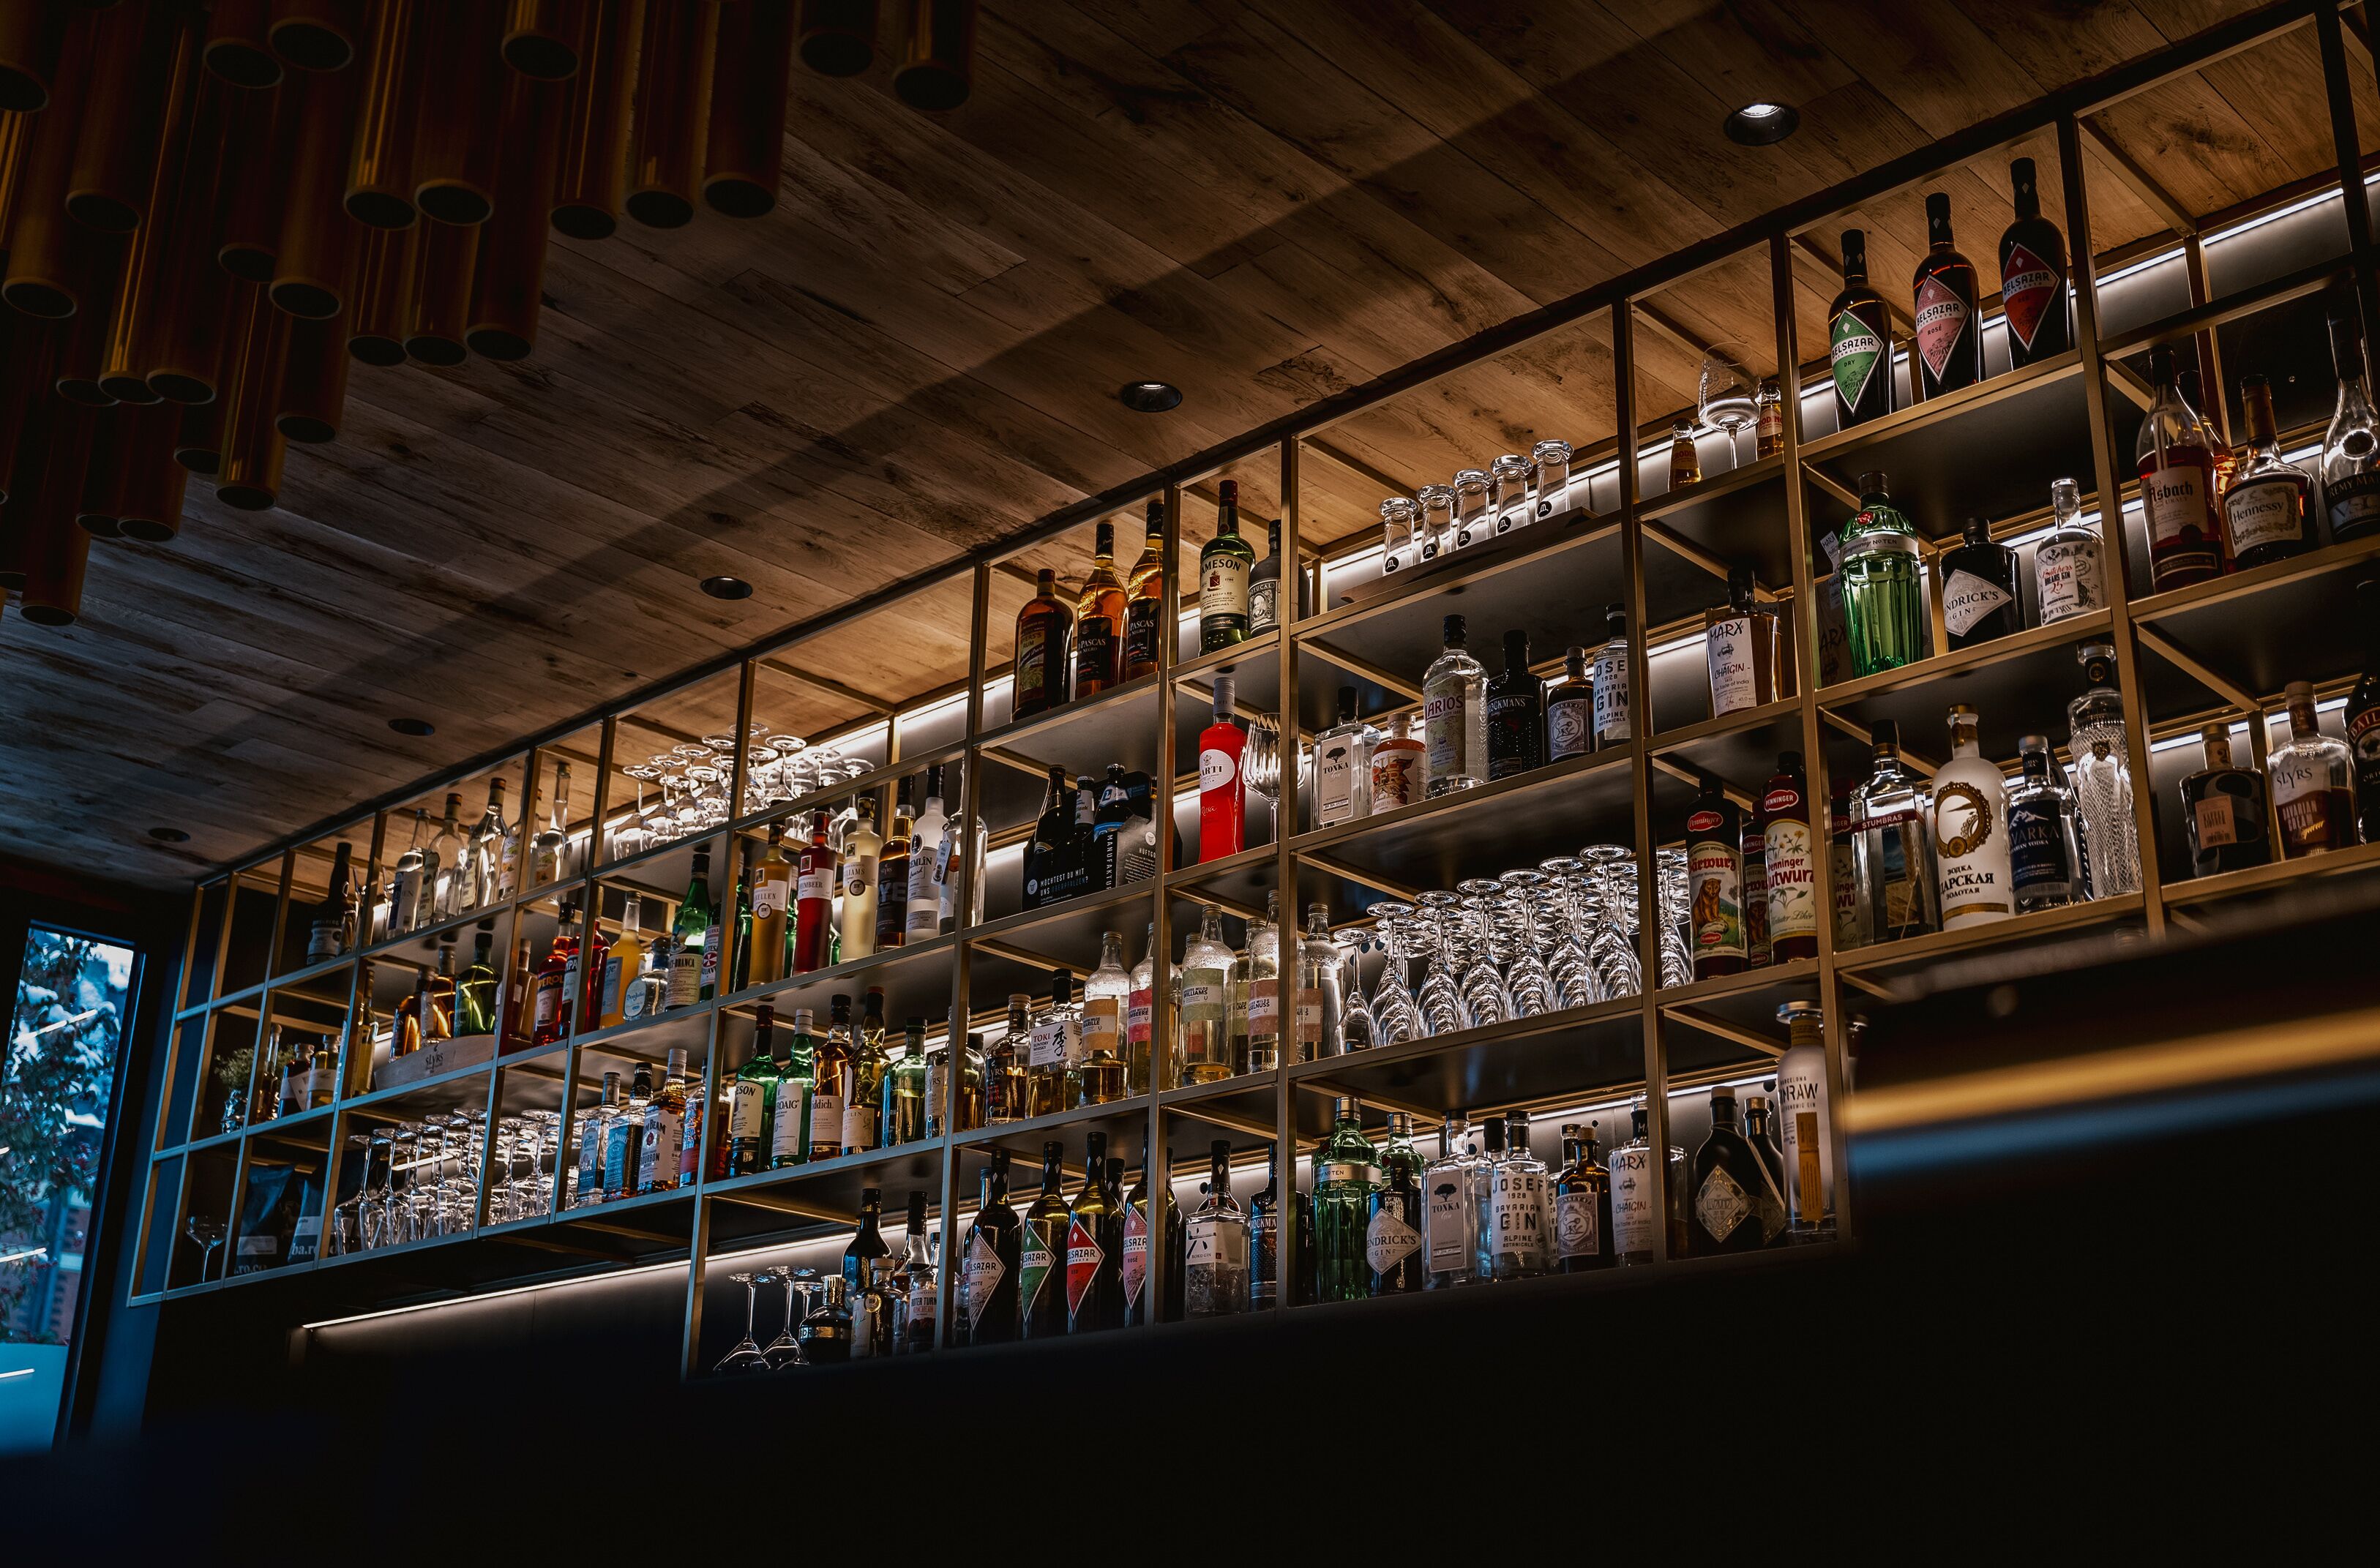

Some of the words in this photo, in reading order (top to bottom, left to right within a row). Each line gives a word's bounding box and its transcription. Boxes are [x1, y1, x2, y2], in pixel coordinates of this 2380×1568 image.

[2003, 271, 2049, 294] BELSAZAR
[1917, 303, 1959, 326] BELSAZAR
[1927, 325, 1942, 335] ROSÉ
[1831, 337, 1874, 358] BELSAZAR
[1844, 359, 1855, 367] DRY
[2149, 481, 2193, 502] Asbach
[2234, 502, 2284, 523] Hennessy
[1201, 559, 1241, 576] AMESON
[1945, 591, 1999, 615] NDRICK'S
[1953, 607, 1971, 619] GIN
[1130, 620, 1154, 631] PASCAS
[1021, 631, 1042, 642] YERS'S
[1710, 620, 1743, 645] MARX
[1081, 639, 1106, 649] PASCAS
[1596, 659, 1625, 678] OSE
[1601, 674, 1618, 682] 1928
[1595, 683, 1627, 698] AVARIA
[1597, 691, 1628, 713] GIN
[1600, 711, 1624, 721] ALPINE
[2350, 712, 2380, 738] BAIL
[1200, 765, 1222, 776] ARTI
[1323, 762, 1349, 774] TONKA
[2277, 765, 2313, 789] SLYRS
[1765, 794, 1794, 806] PENNINGER
[1689, 815, 1720, 828] Penninger
[1862, 814, 1903, 829] STUMBRAS
[1768, 858, 1804, 873] Penninger
[879, 881, 907, 903] YE
[1040, 888, 1050, 896] UNS
[539, 974, 564, 988] PEROL
[1183, 990, 1208, 998] WILLIAMS
[1249, 1002, 1270, 1011] SELNUSS
[1033, 1033, 1050, 1043] TOKI
[736, 1087, 756, 1096] ESON
[1778, 1084, 1819, 1102] INRAW
[777, 1100, 798, 1109] ROAIG
[812, 1099, 832, 1111] iddich
[650, 1119, 666, 1134] BEAM
[1611, 1153, 1646, 1172] MARX
[1492, 1177, 1543, 1194] JOSEF
[1432, 1201, 1460, 1212] TONKA
[1496, 1204, 1541, 1212] BAVARIAN
[1251, 1217, 1276, 1229] ROCKMA
[1500, 1213, 1536, 1231] GIN
[1123, 1237, 1147, 1248] ELSAZA
[1367, 1235, 1416, 1249] ENDRICK'S
[1022, 1253, 1047, 1263] LSAZAR
[1068, 1249, 1096, 1259] ELSAZAR
[970, 1262, 997, 1272] ELSAZAR
